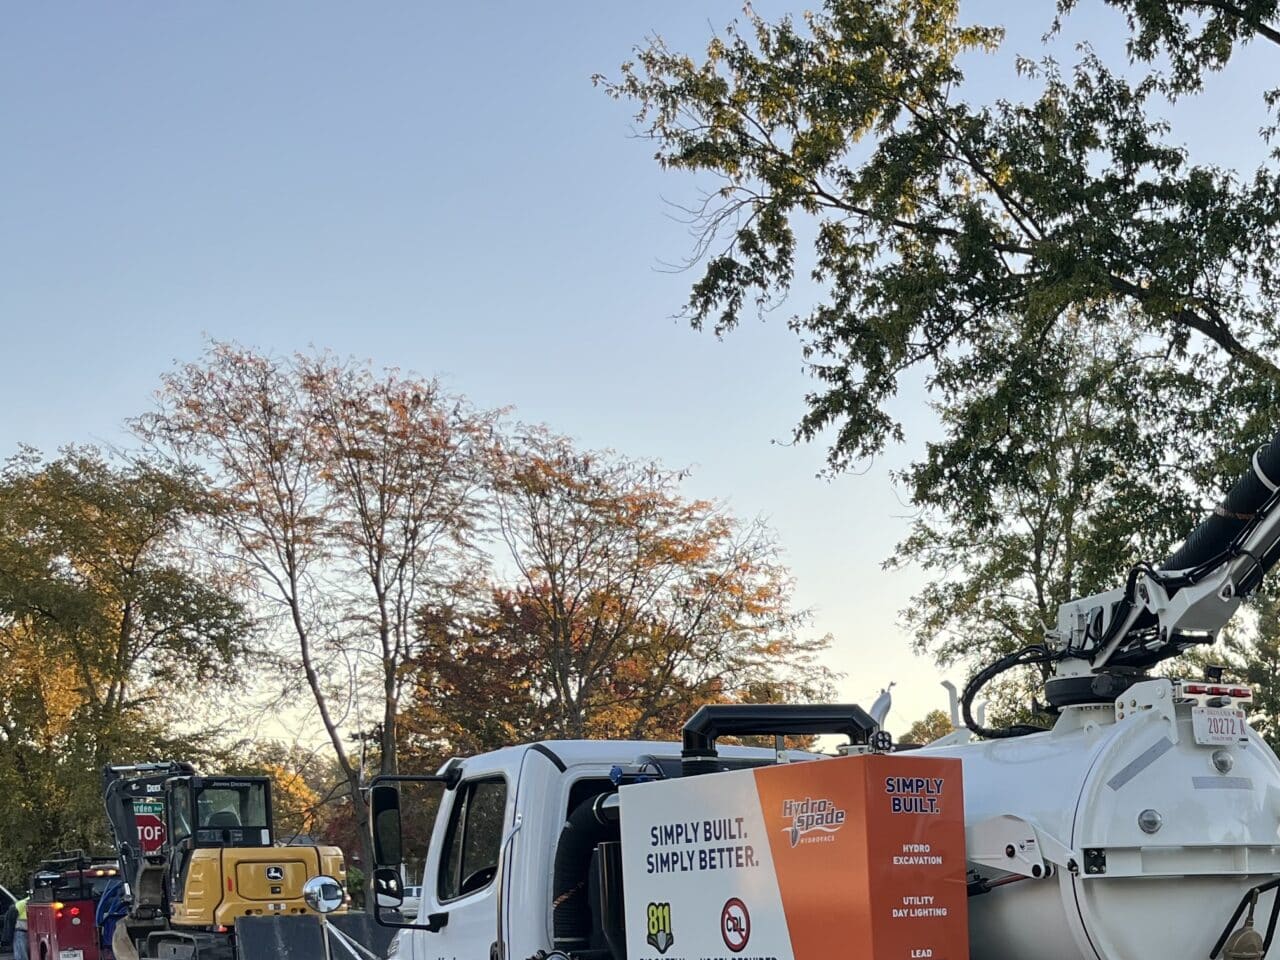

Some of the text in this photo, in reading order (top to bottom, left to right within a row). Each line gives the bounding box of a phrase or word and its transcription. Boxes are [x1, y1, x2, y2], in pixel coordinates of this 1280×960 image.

[1208, 718, 1236, 735] 20272
[886, 777, 943, 794] SIMPLY
[783, 797, 833, 818] Hydro-
[892, 797, 940, 813] BUILT.
[796, 807, 845, 831] spade
[136, 826, 164, 840] TOP
[650, 818, 747, 847] SIMPLY BUILT.
[903, 844, 930, 853] HYDRO
[646, 845, 759, 874] SIMPLY BETTER.
[893, 856, 943, 865] EXCAVATION
[903, 896, 934, 905] UTILITY
[647, 902, 671, 935] 811
[892, 908, 948, 918] DAY LIGHTING
[726, 916, 745, 932] CDL
[911, 949, 932, 958] LEAD
